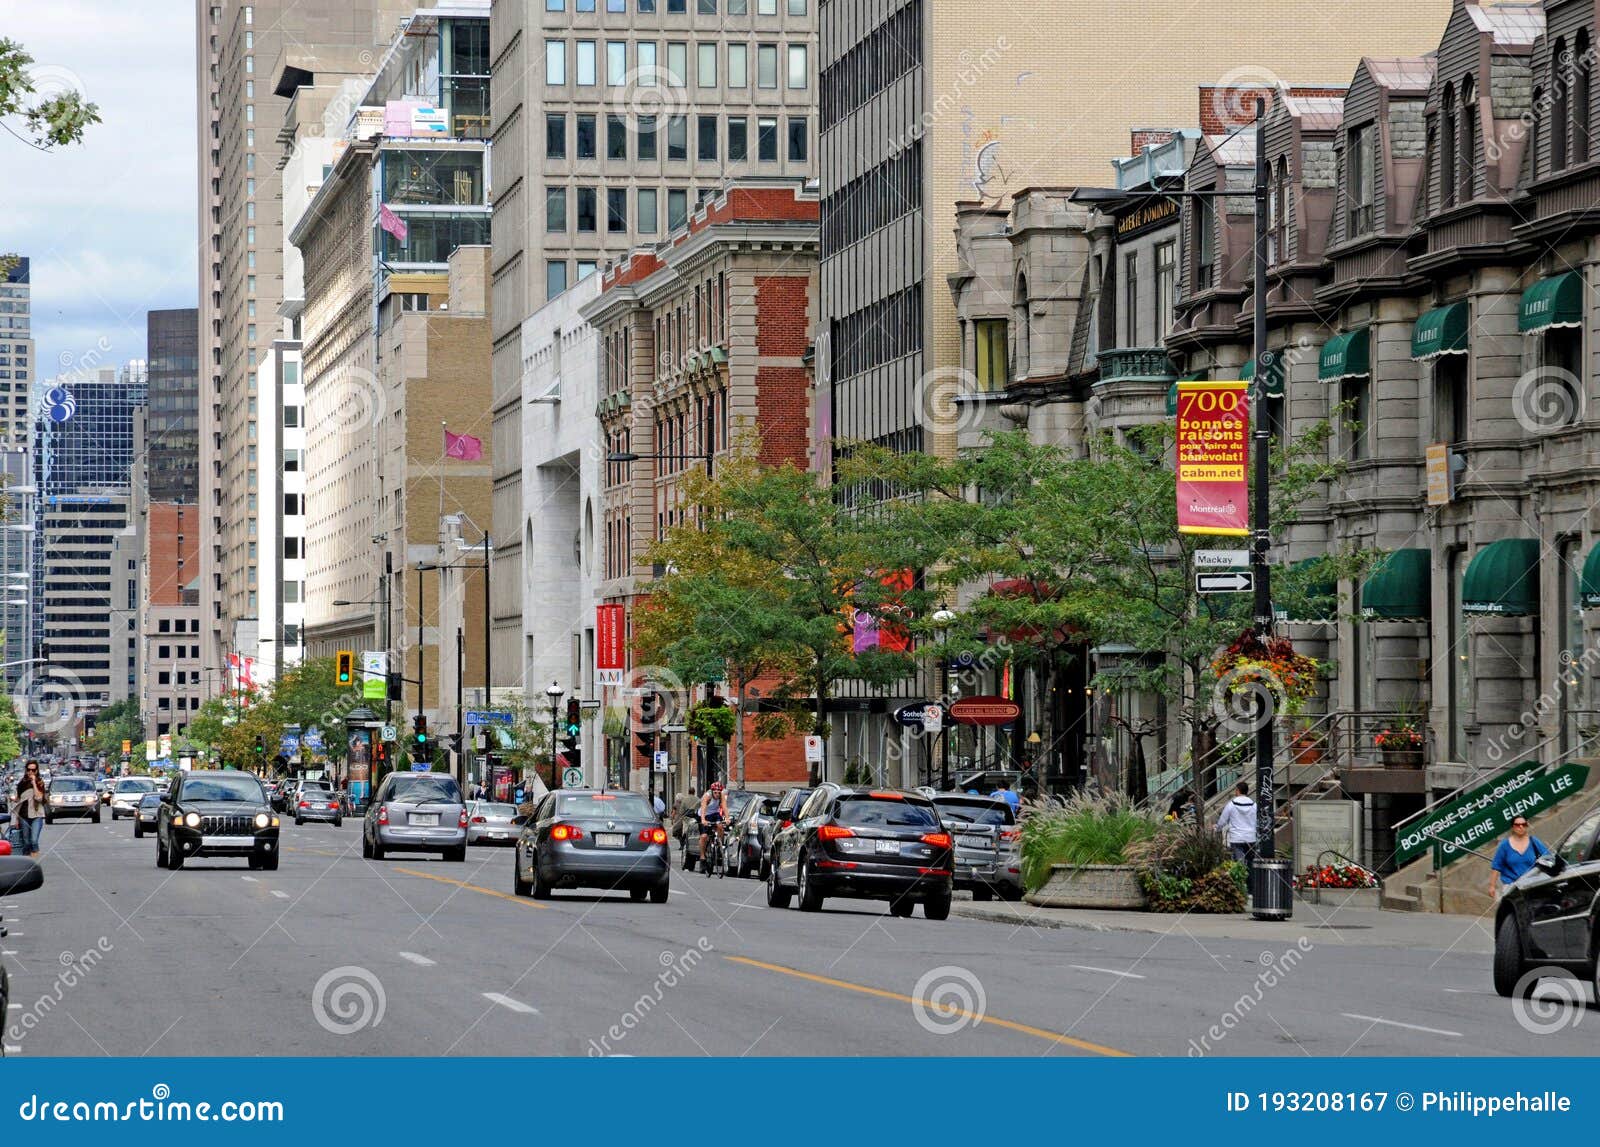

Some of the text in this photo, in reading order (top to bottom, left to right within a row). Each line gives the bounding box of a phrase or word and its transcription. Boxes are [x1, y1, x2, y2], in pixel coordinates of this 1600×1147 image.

[1180, 391, 1238, 417] 700
[1180, 418, 1243, 429] bonnes
[1180, 429, 1243, 440] raisons
[1181, 468, 1242, 478] cabm.net
[1190, 504, 1226, 513] Montréal
[1197, 554, 1233, 566] Mackay
[1442, 774, 1573, 854] GALERIE ELENA LEE
[1401, 813, 1455, 850] BOUTIQUE
[1457, 802, 1475, 818] DE
[1476, 793, 1494, 808] LA
